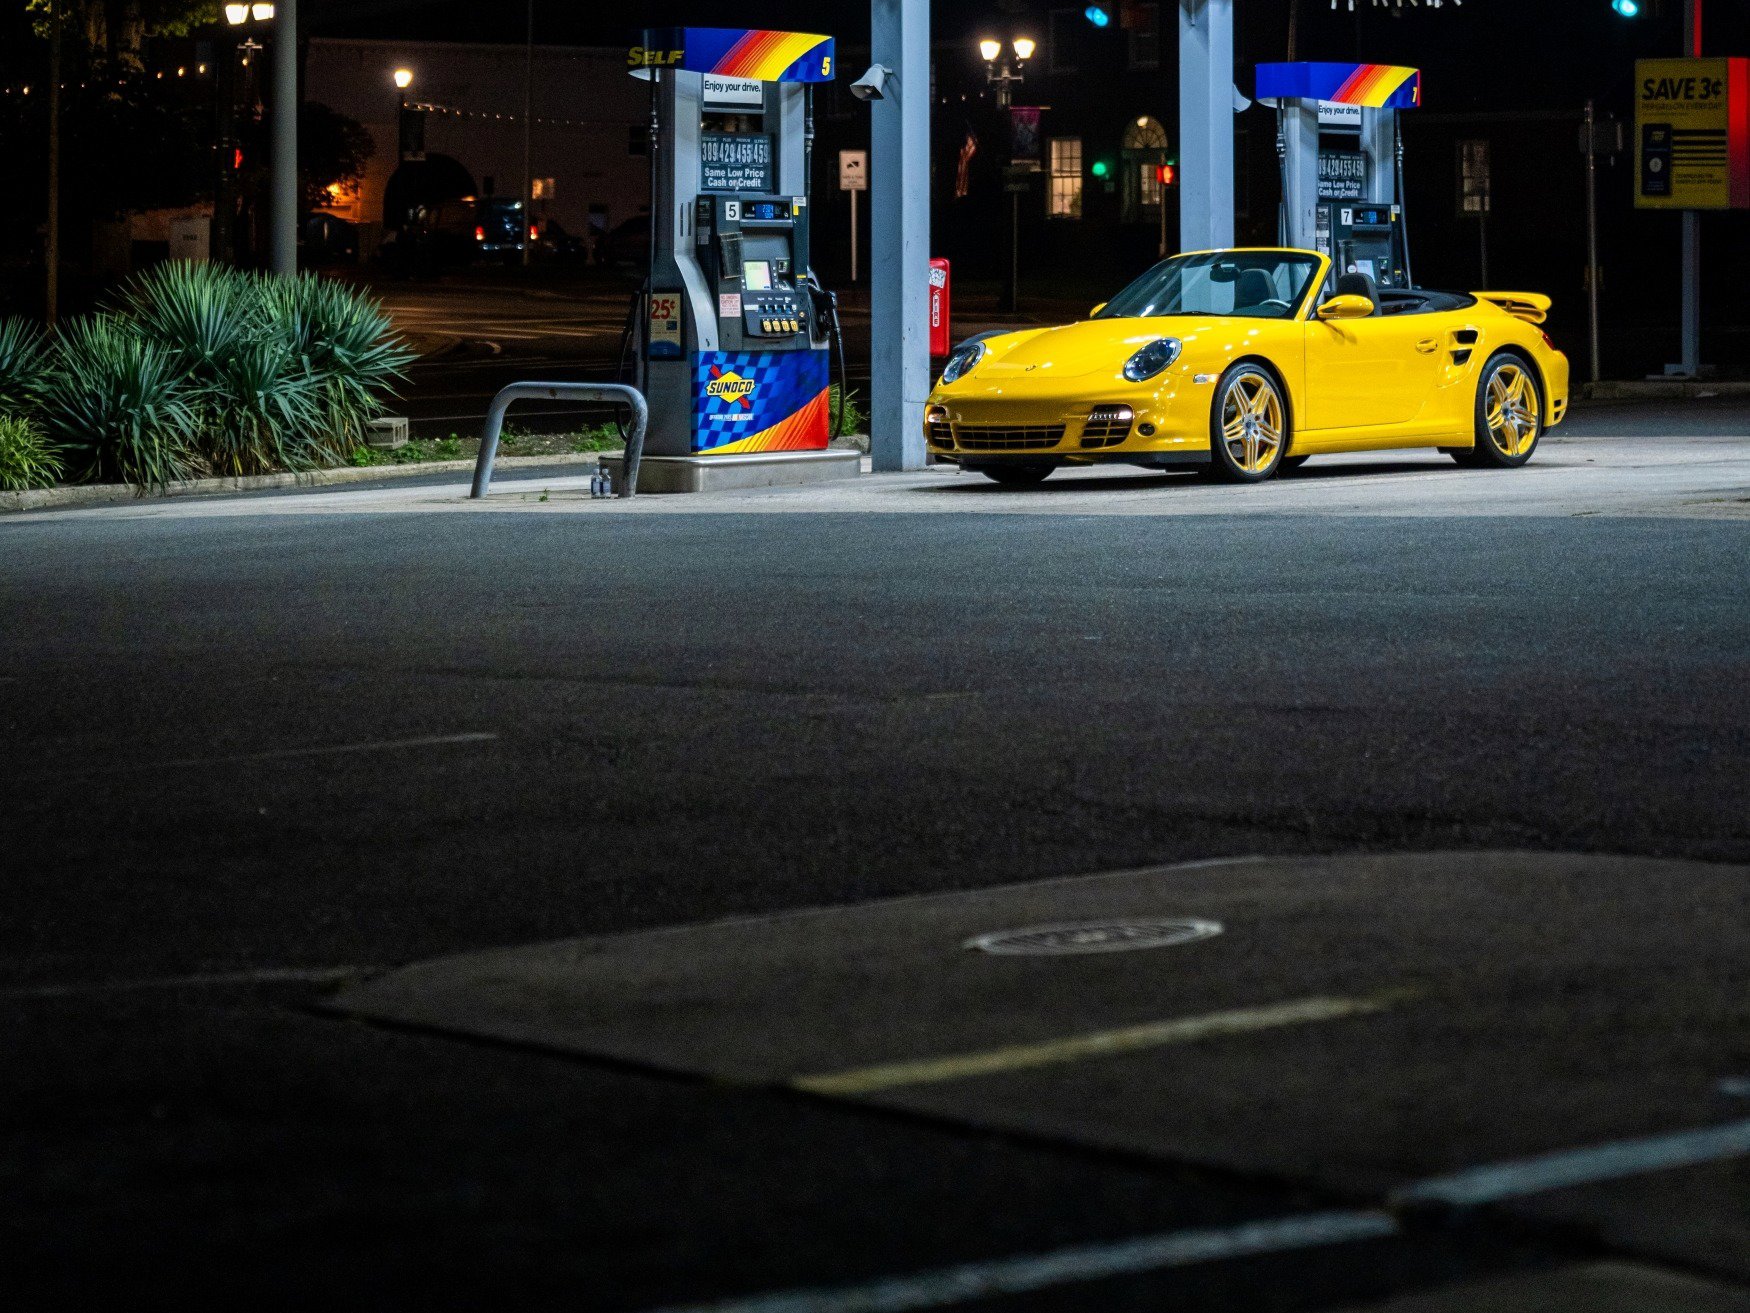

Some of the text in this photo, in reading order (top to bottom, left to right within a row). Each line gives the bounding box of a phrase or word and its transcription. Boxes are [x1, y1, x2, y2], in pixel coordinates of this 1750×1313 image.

[627, 47, 684, 65] SELF
[821, 56, 831, 76] 5
[704, 80, 761, 92] Enjoy your drive.
[1642, 77, 1723, 100] SAVE 3¢
[1318, 105, 1359, 115] Enjoy your drive.
[704, 167, 765, 178] Same Low Price
[708, 177, 726, 187] Cash
[738, 178, 761, 187] Credit
[1318, 180, 1361, 189] ame Low Price
[1318, 188, 1333, 196] Cash
[1340, 188, 1358, 197] Credit
[729, 204, 737, 218] 5
[1343, 211, 1350, 223] 7
[709, 381, 753, 394] SUNOCO
